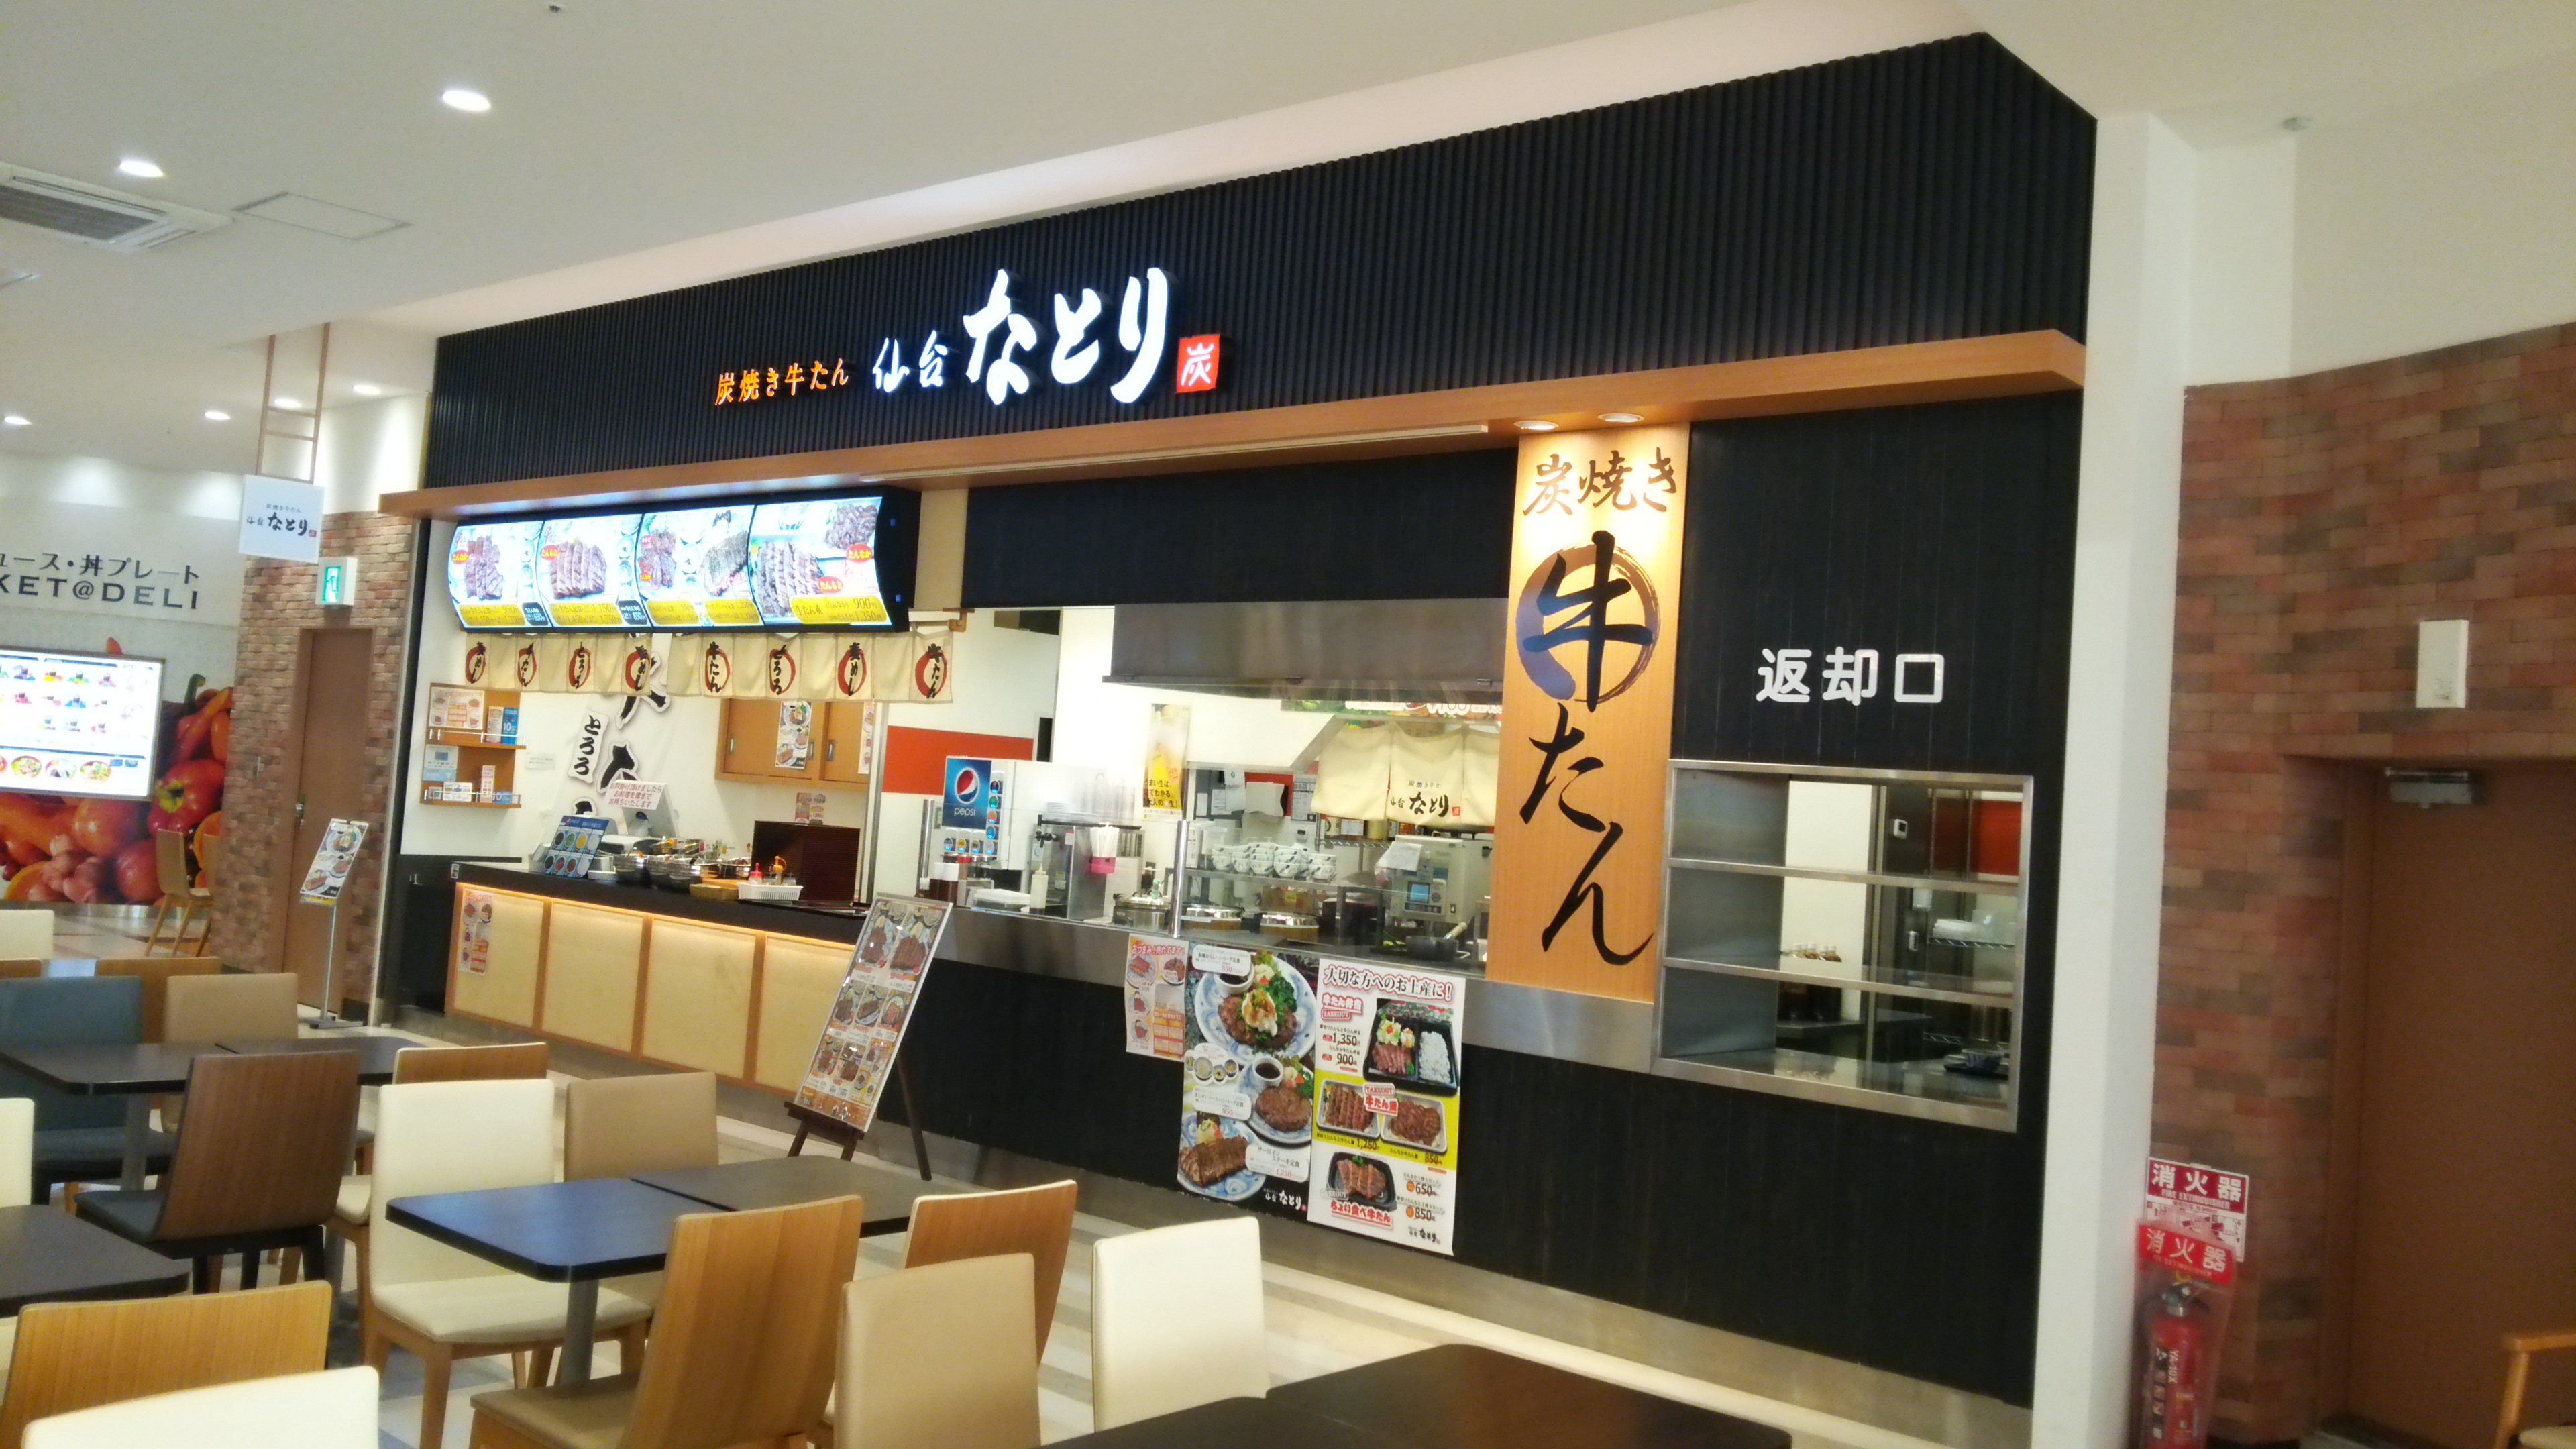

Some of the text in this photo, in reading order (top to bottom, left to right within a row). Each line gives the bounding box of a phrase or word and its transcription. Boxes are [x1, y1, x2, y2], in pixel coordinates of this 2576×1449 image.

[714, 358, 849, 405] 炭焼き牛たん
[962, 267, 1169, 405] なとり
[1523, 446, 1677, 516] 炭焼き
[709, 641, 721, 694] 牛たん
[773, 645, 786, 695] とろろ
[1756, 646, 1945, 706] 返却口
[1521, 530, 1654, 965] 牛たん
[954, 807, 976, 817] pepsi
[1409, 792, 1449, 817] なとり
[2151, 1163, 2242, 1203] 消火器
[2161, 1189, 2178, 1199] FIRE
[2179, 1193, 2231, 1210] EXTINGUISHER
[2146, 1228, 2227, 1273] 消火器
